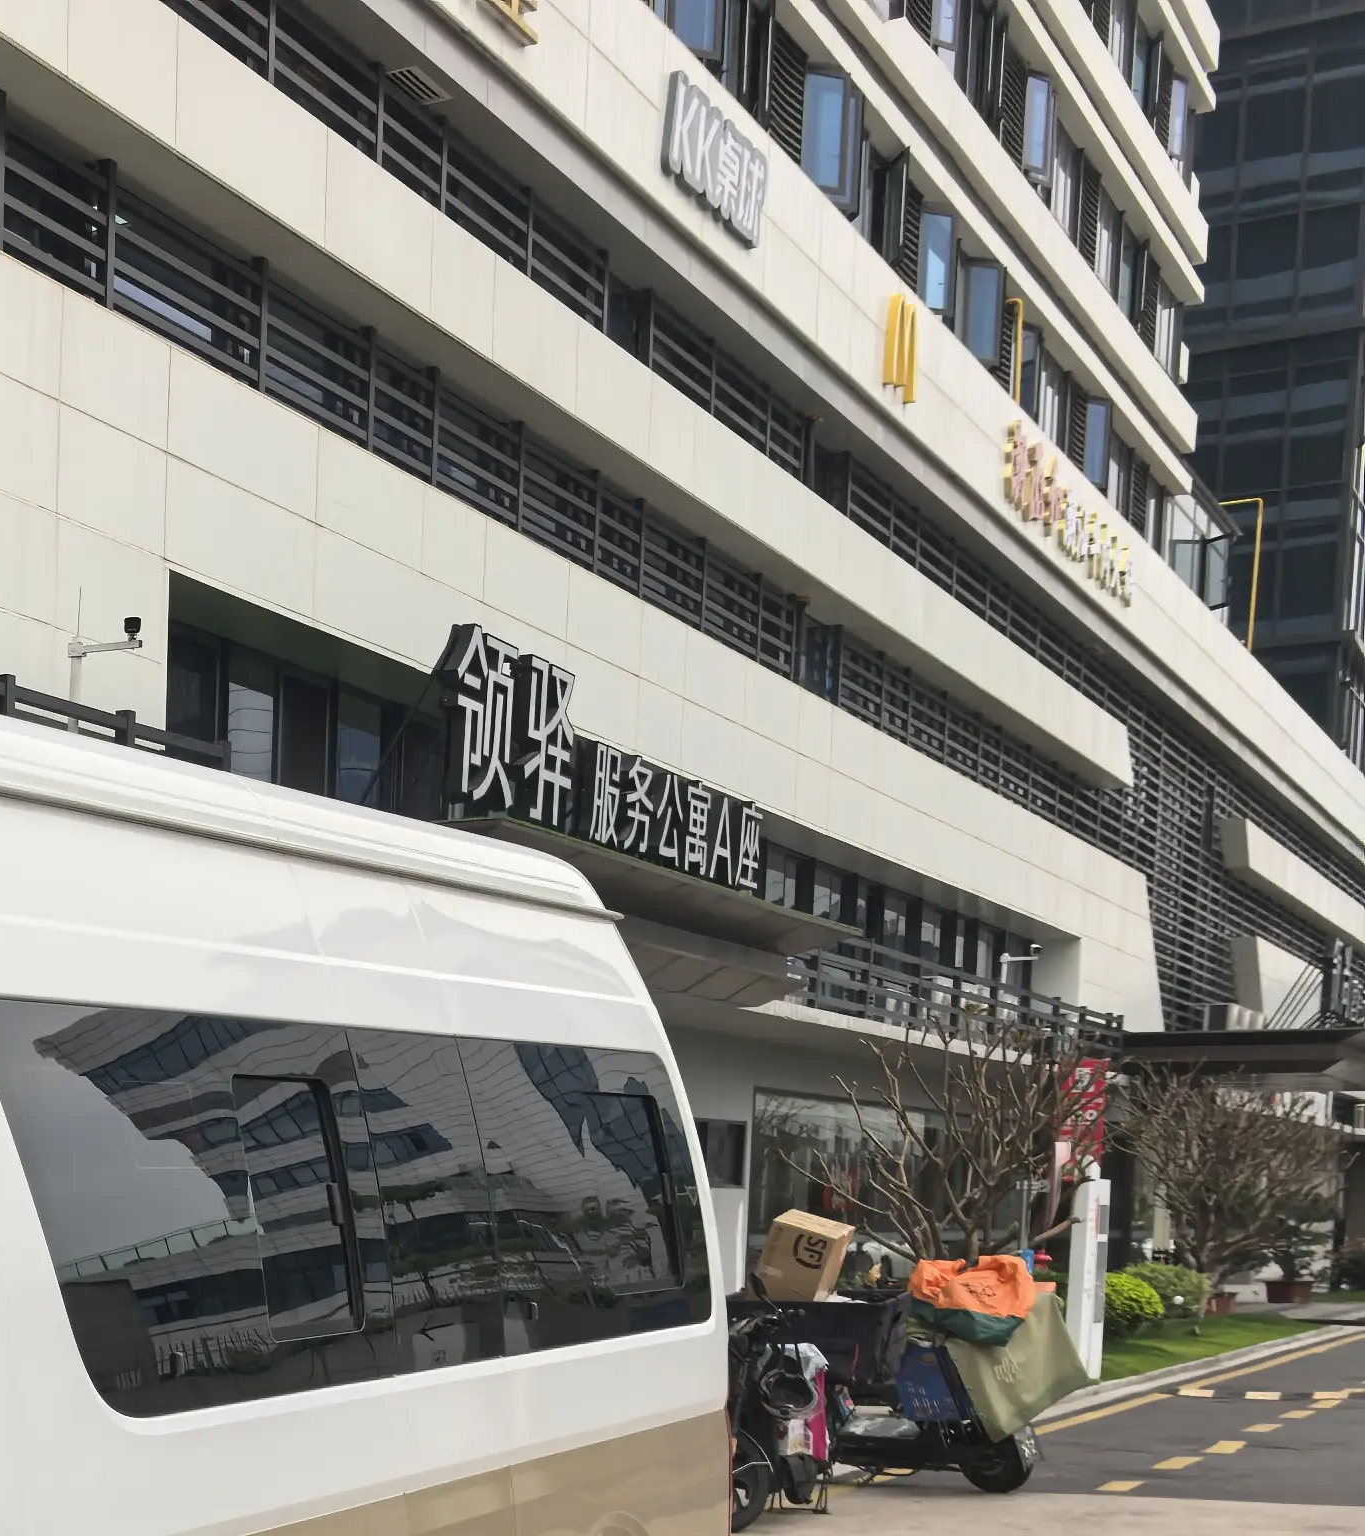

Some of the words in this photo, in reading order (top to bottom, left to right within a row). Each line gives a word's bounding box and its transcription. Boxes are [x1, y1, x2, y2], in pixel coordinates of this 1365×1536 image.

[669, 80, 766, 238] KK桌球
[457, 625, 576, 827] 领驿
[589, 742, 764, 890] 服务公寓A座
